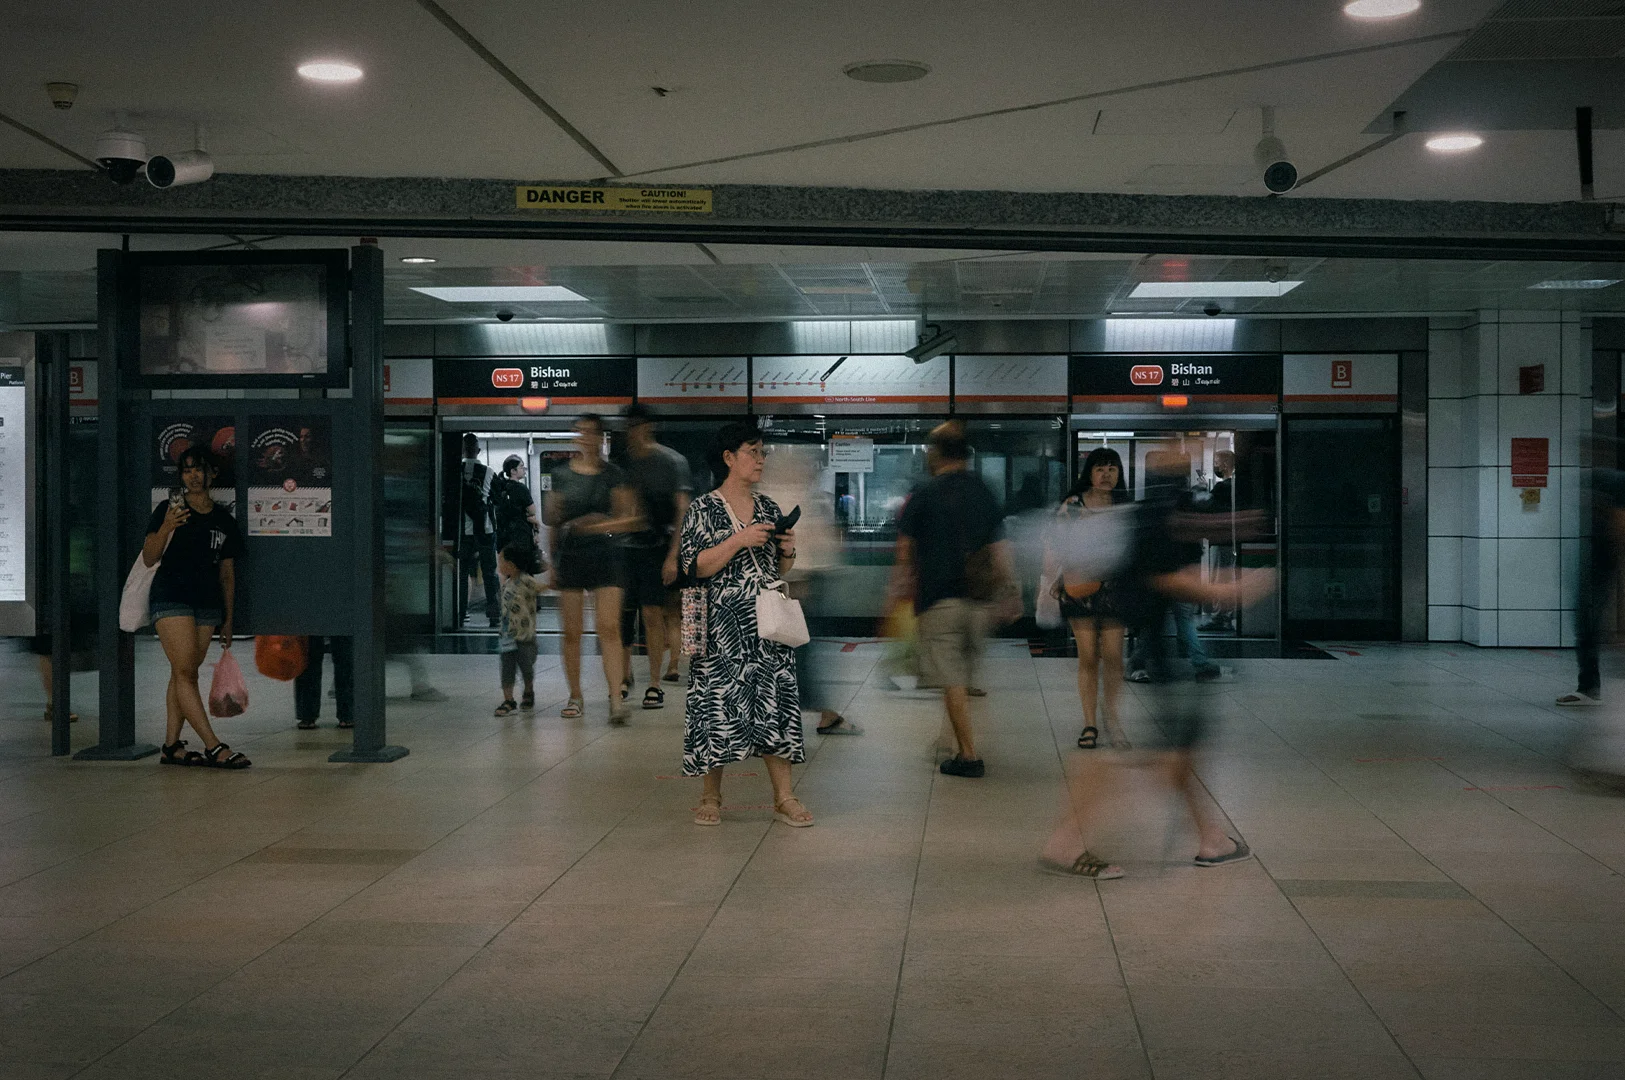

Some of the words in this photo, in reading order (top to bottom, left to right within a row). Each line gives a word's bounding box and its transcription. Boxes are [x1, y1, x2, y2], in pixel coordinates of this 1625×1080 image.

[527, 190, 605, 203] DANGER
[641, 190, 687, 198] CAUTION!
[530, 366, 570, 378] Bishan
[1171, 363, 1213, 375] Bishan
[1337, 365, 1347, 379] B
[0, 372, 12, 380] Pier
[70, 371, 79, 385] B
[496, 374, 508, 382] NS
[509, 374, 519, 382] 17
[1135, 371, 1147, 380] NS
[1148, 371, 1159, 379] 17
